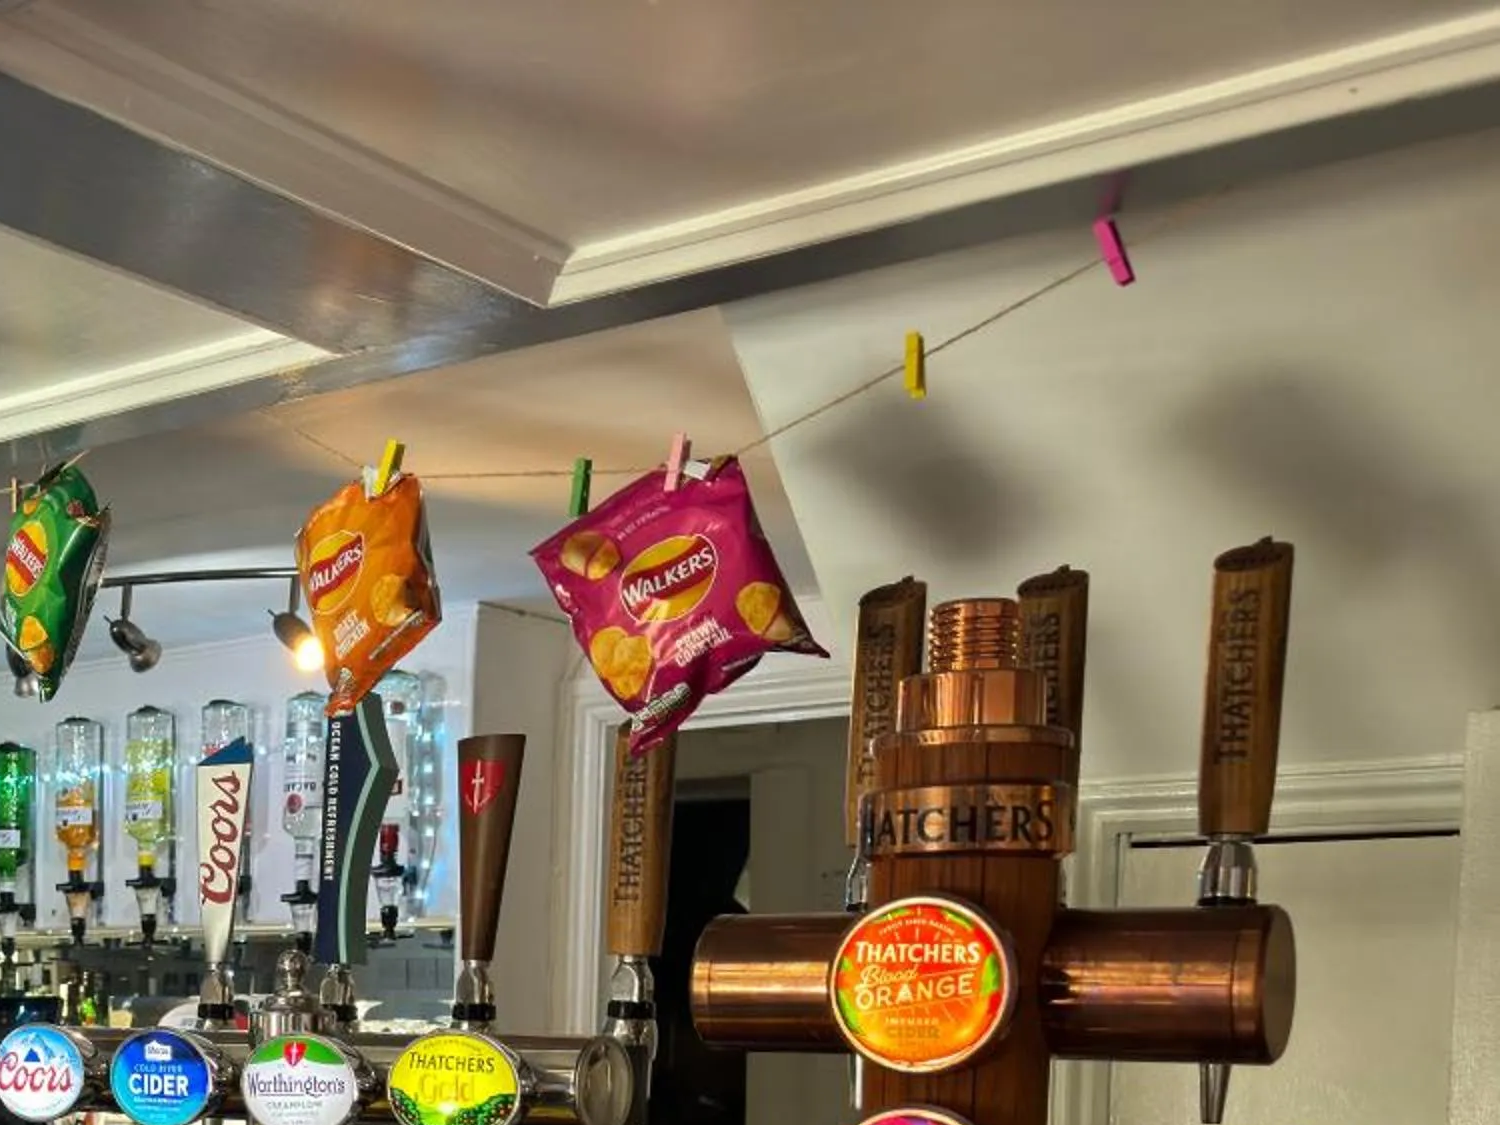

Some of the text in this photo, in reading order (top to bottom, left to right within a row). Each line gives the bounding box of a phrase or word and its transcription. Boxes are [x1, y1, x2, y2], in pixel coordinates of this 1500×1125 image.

[622, 546, 713, 607] WALKERS
[1214, 587, 1260, 766] THATCHERS
[329, 721, 341, 761] OCEAN
[327, 765, 339, 796] COLD
[200, 770, 241, 906] Coors
[613, 754, 648, 907] THATCHERS
[860, 802, 1054, 849] HATCHERS
[855, 940, 980, 965] THATCHERS
[854, 973, 975, 1011] ORANGE
[409, 1051, 495, 1073] THATCHERS
[128, 1073, 189, 1097] CIDER
[249, 1071, 346, 1098] Worthington's
[418, 1073, 475, 1104] Gold
